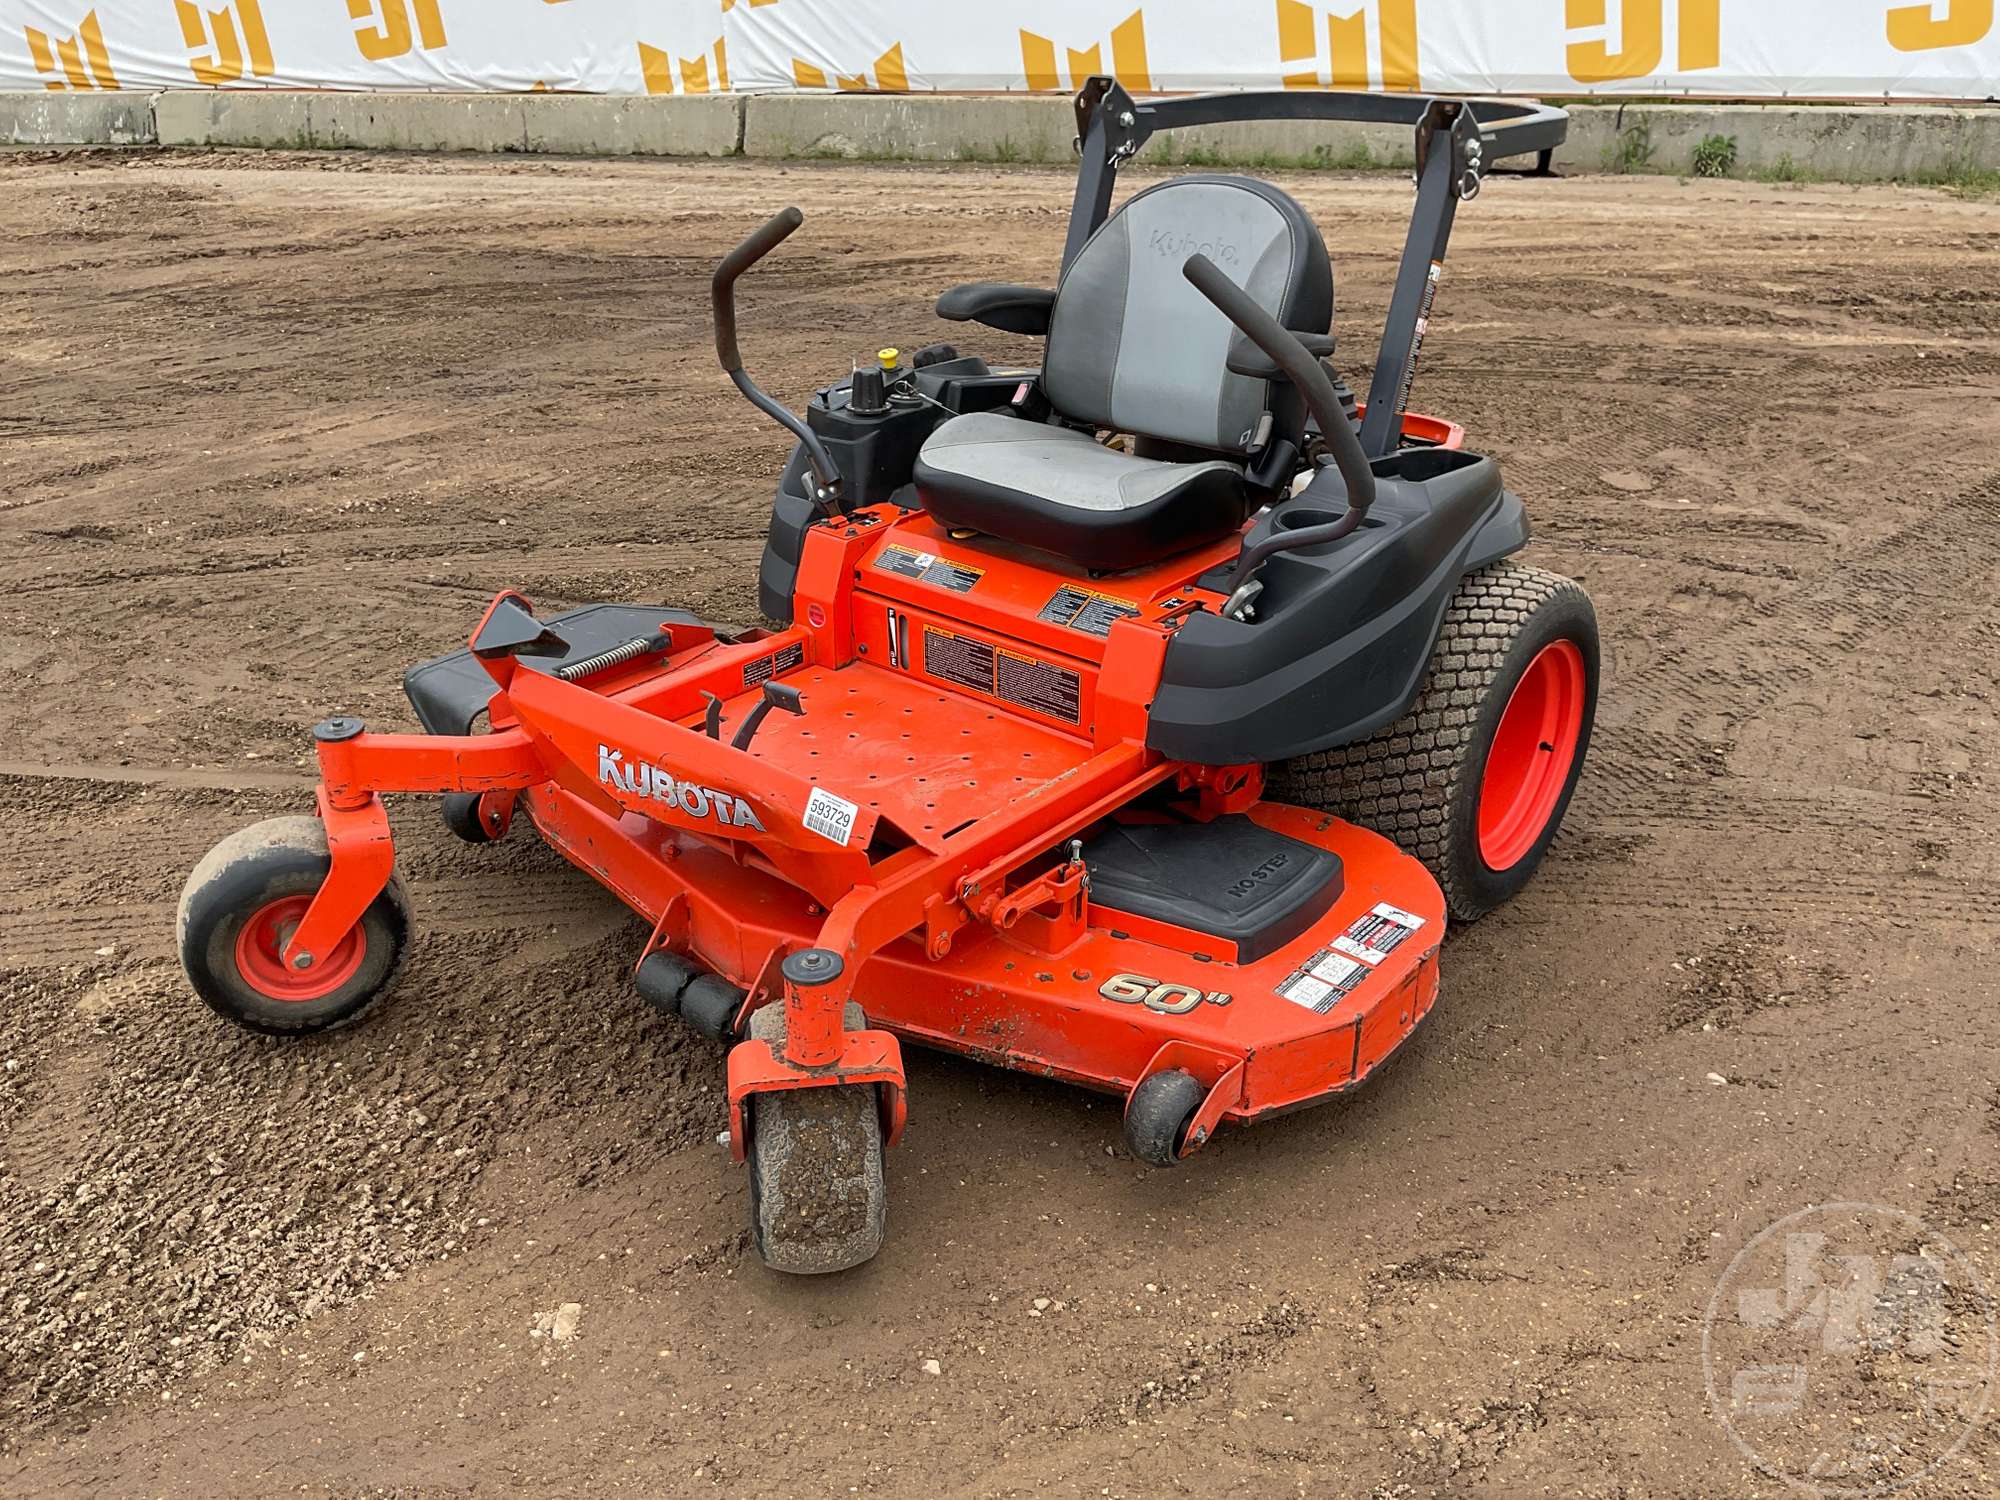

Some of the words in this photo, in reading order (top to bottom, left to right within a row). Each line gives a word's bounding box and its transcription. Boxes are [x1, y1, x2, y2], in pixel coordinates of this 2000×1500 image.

[598, 744, 767, 833] KUBOTA
[810, 799, 851, 828] 593729
[1226, 879, 1256, 898] NO
[1251, 852, 1289, 880] STEP
